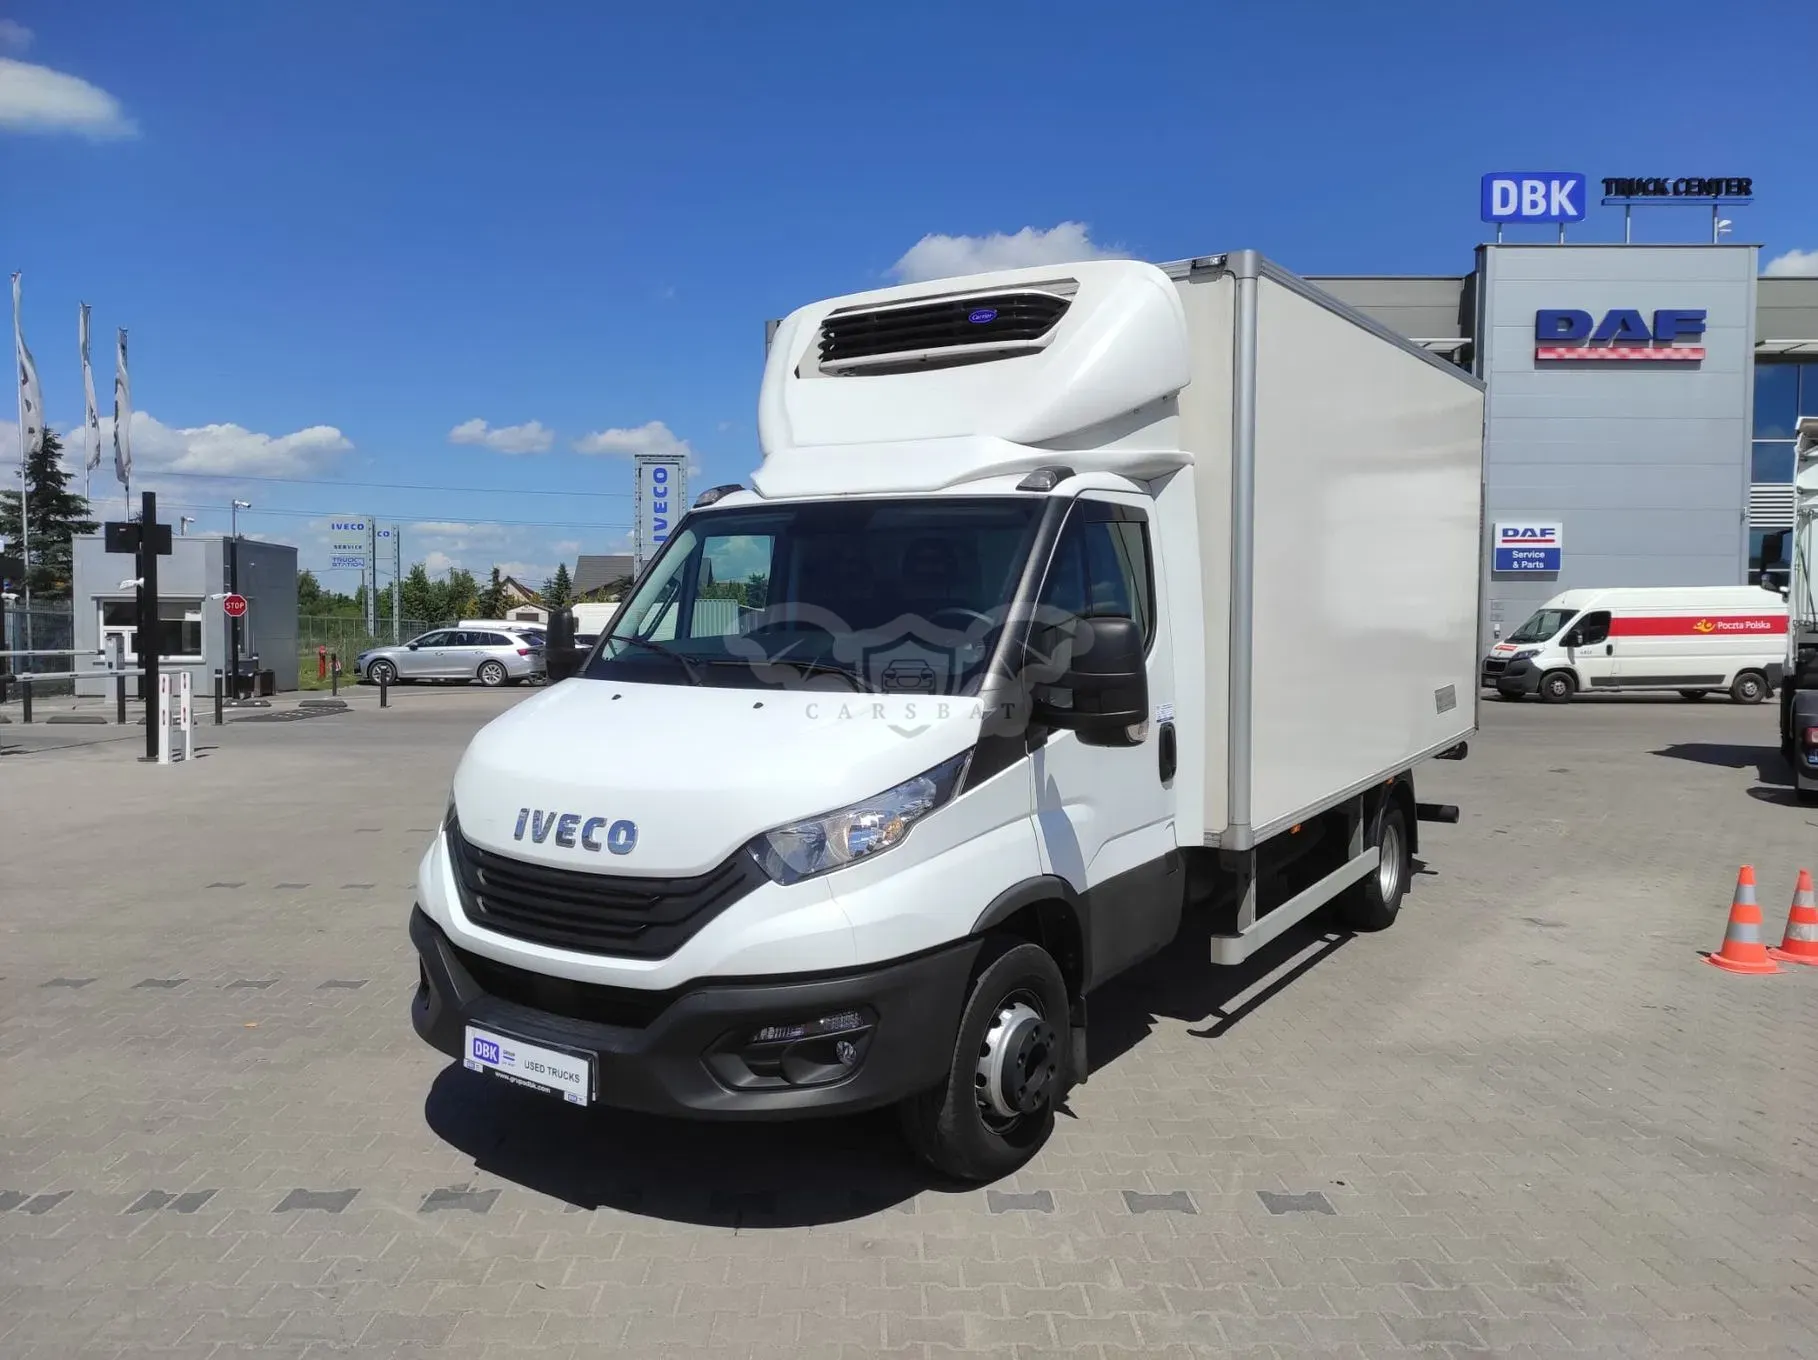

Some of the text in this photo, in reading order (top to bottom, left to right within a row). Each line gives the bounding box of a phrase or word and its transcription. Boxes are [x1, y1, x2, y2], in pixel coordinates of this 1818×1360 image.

[1491, 179, 1578, 216] DBK
[1601, 177, 1753, 197] TRUCK CENTER
[1535, 309, 1707, 342] DAF
[653, 467, 668, 542] IVECO
[331, 523, 365, 531] IVECO
[1502, 528, 1556, 537] DAF
[1512, 550, 1545, 559] Service
[1717, 621, 1771, 629] Poczta Polska
[513, 807, 639, 855] IVECO
[475, 1040, 498, 1062] DBK
[524, 1061, 581, 1084] USED TRUCKS
